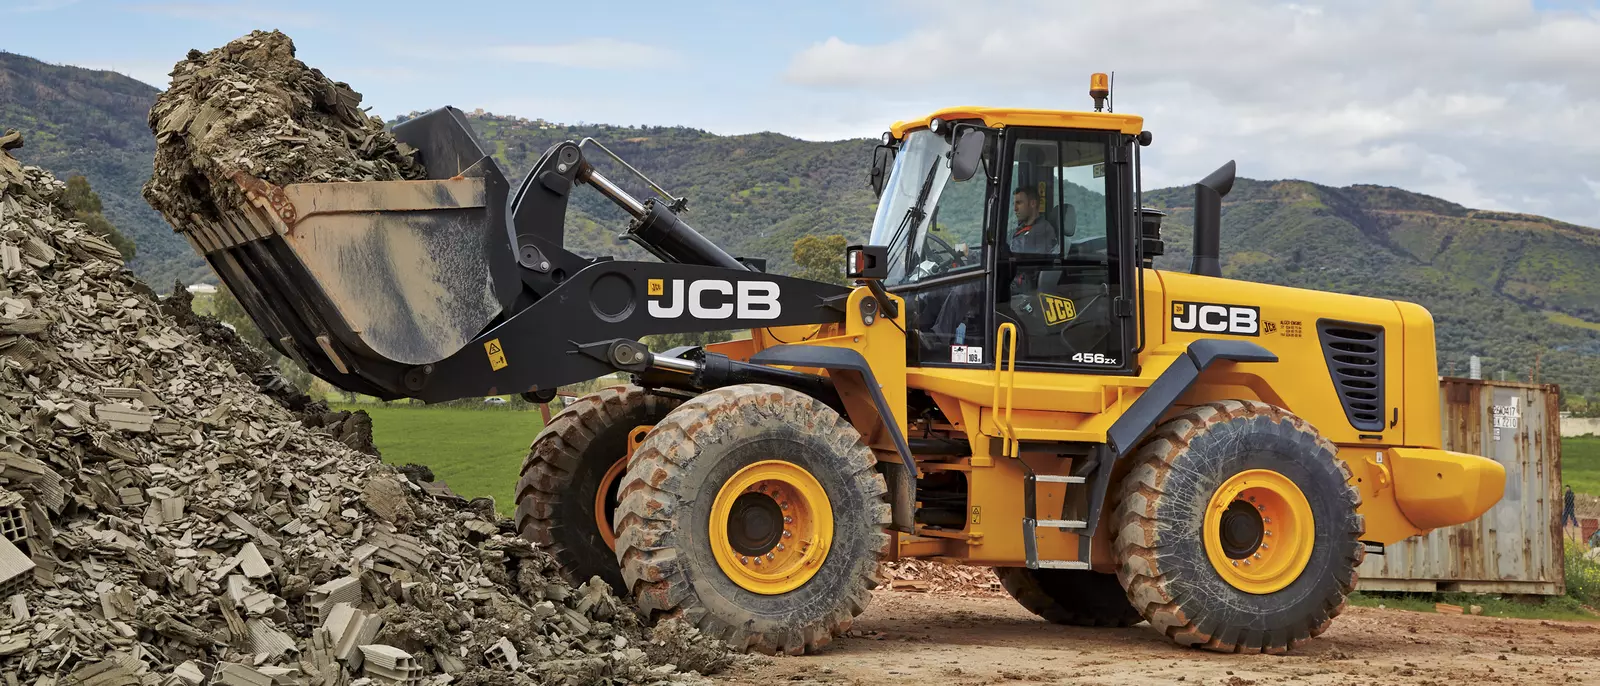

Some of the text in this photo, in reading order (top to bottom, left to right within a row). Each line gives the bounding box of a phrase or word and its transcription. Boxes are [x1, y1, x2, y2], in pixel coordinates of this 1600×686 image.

[648, 279, 782, 319] JCB
[1045, 297, 1074, 323] JCB
[1173, 304, 1258, 334] JCB
[1263, 321, 1277, 333] JCB
